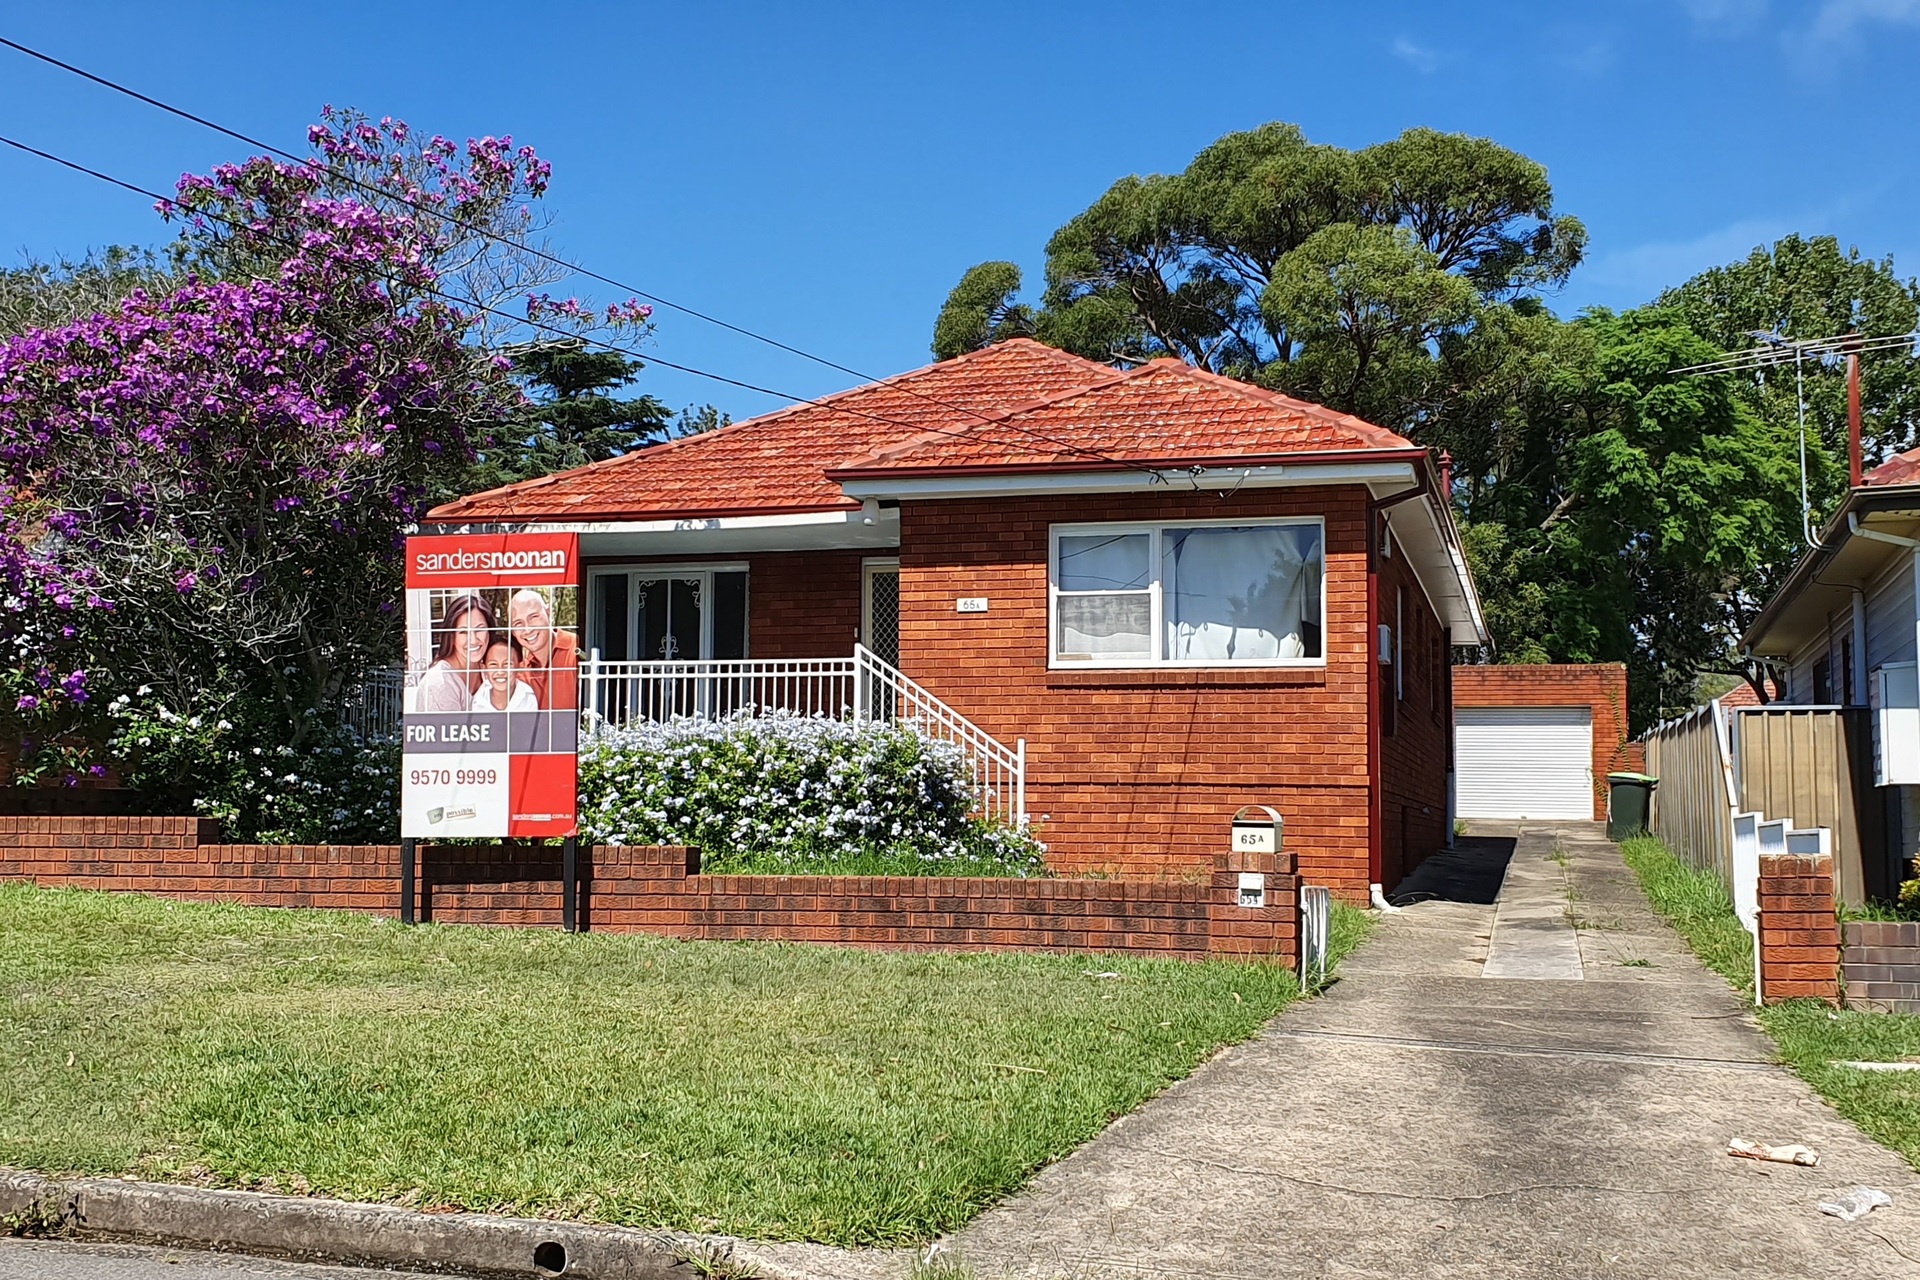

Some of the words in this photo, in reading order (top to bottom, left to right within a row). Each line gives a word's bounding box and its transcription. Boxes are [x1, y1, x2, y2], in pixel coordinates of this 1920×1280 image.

[416, 548, 565, 571] sandersnoonan
[406, 725, 436, 743] FOR
[441, 724, 491, 742] LEASE
[410, 769, 450, 785] 9570
[456, 769, 497, 784] 9999
[1241, 834, 1265, 845] 65A
